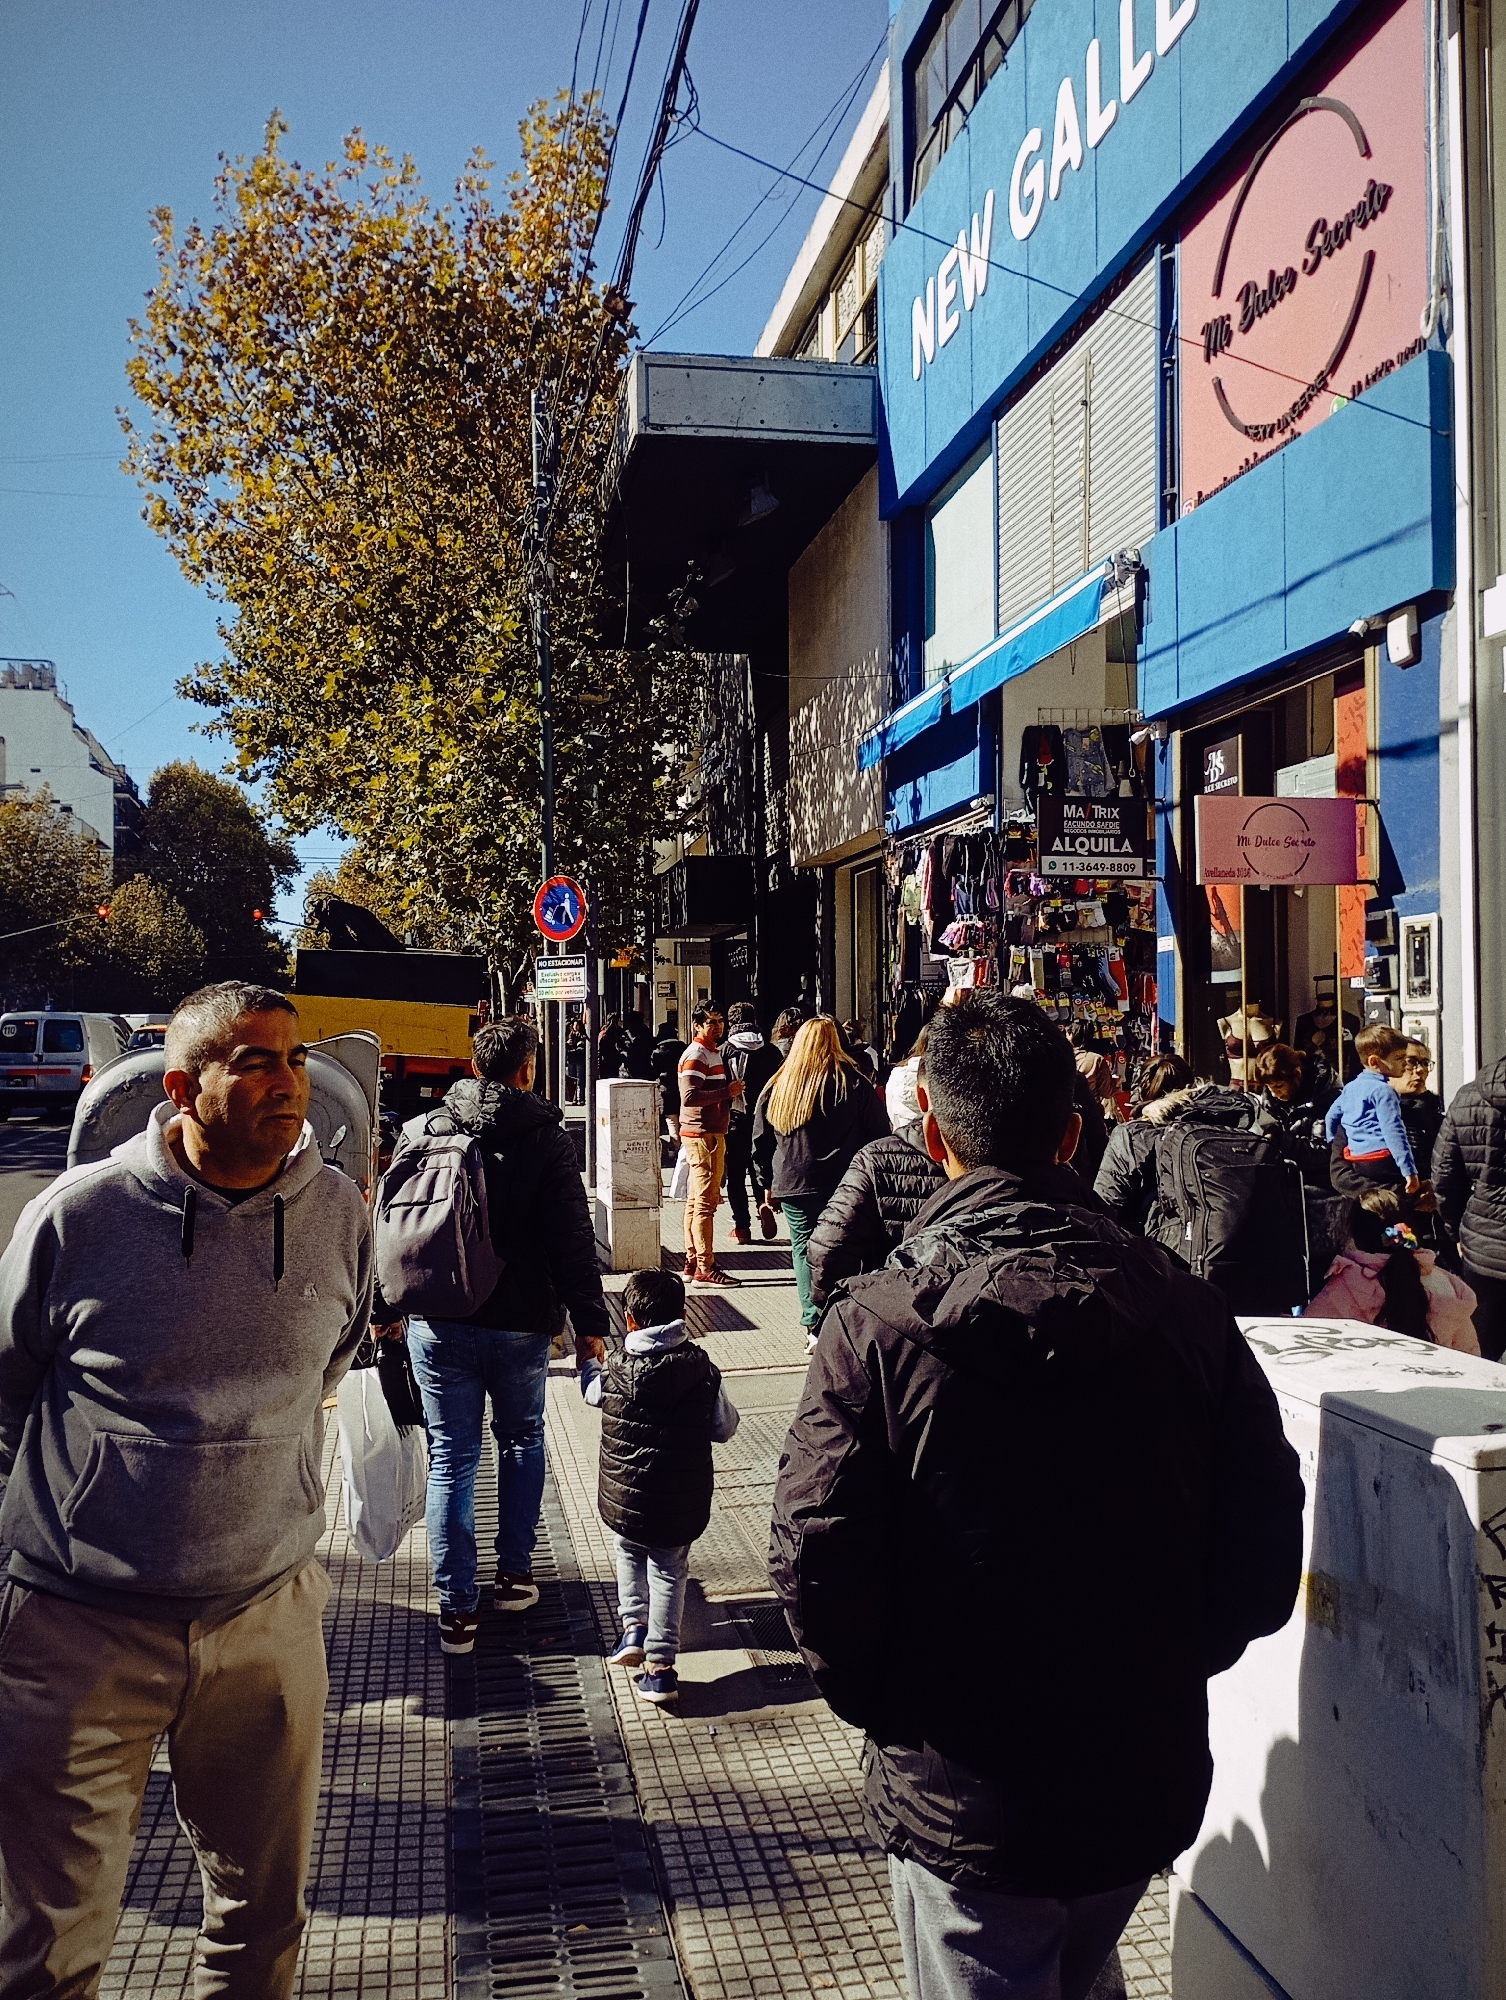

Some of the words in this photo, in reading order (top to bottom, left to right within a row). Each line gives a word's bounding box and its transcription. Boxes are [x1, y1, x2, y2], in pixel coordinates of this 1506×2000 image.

[1201, 314, 1232, 364] Mi
[1236, 267, 1298, 334] Dulce
[1302, 178, 1393, 277] Secreto
[912, 189, 995, 381] NEW
[1215, 775, 1238, 791] SECRETO
[1063, 820, 1095, 828] FACUNDO
[1051, 836, 1133, 856] ALQUILA
[1237, 834, 1251, 847] Mi
[1254, 835, 1280, 848] Dulce
[1283, 835, 1316, 849] Secreto
[1062, 862, 1136, 872] 11-3649-8809
[547, 958, 583, 967] ESTACIONAR
[4, 1026, 15, 1035] 110
